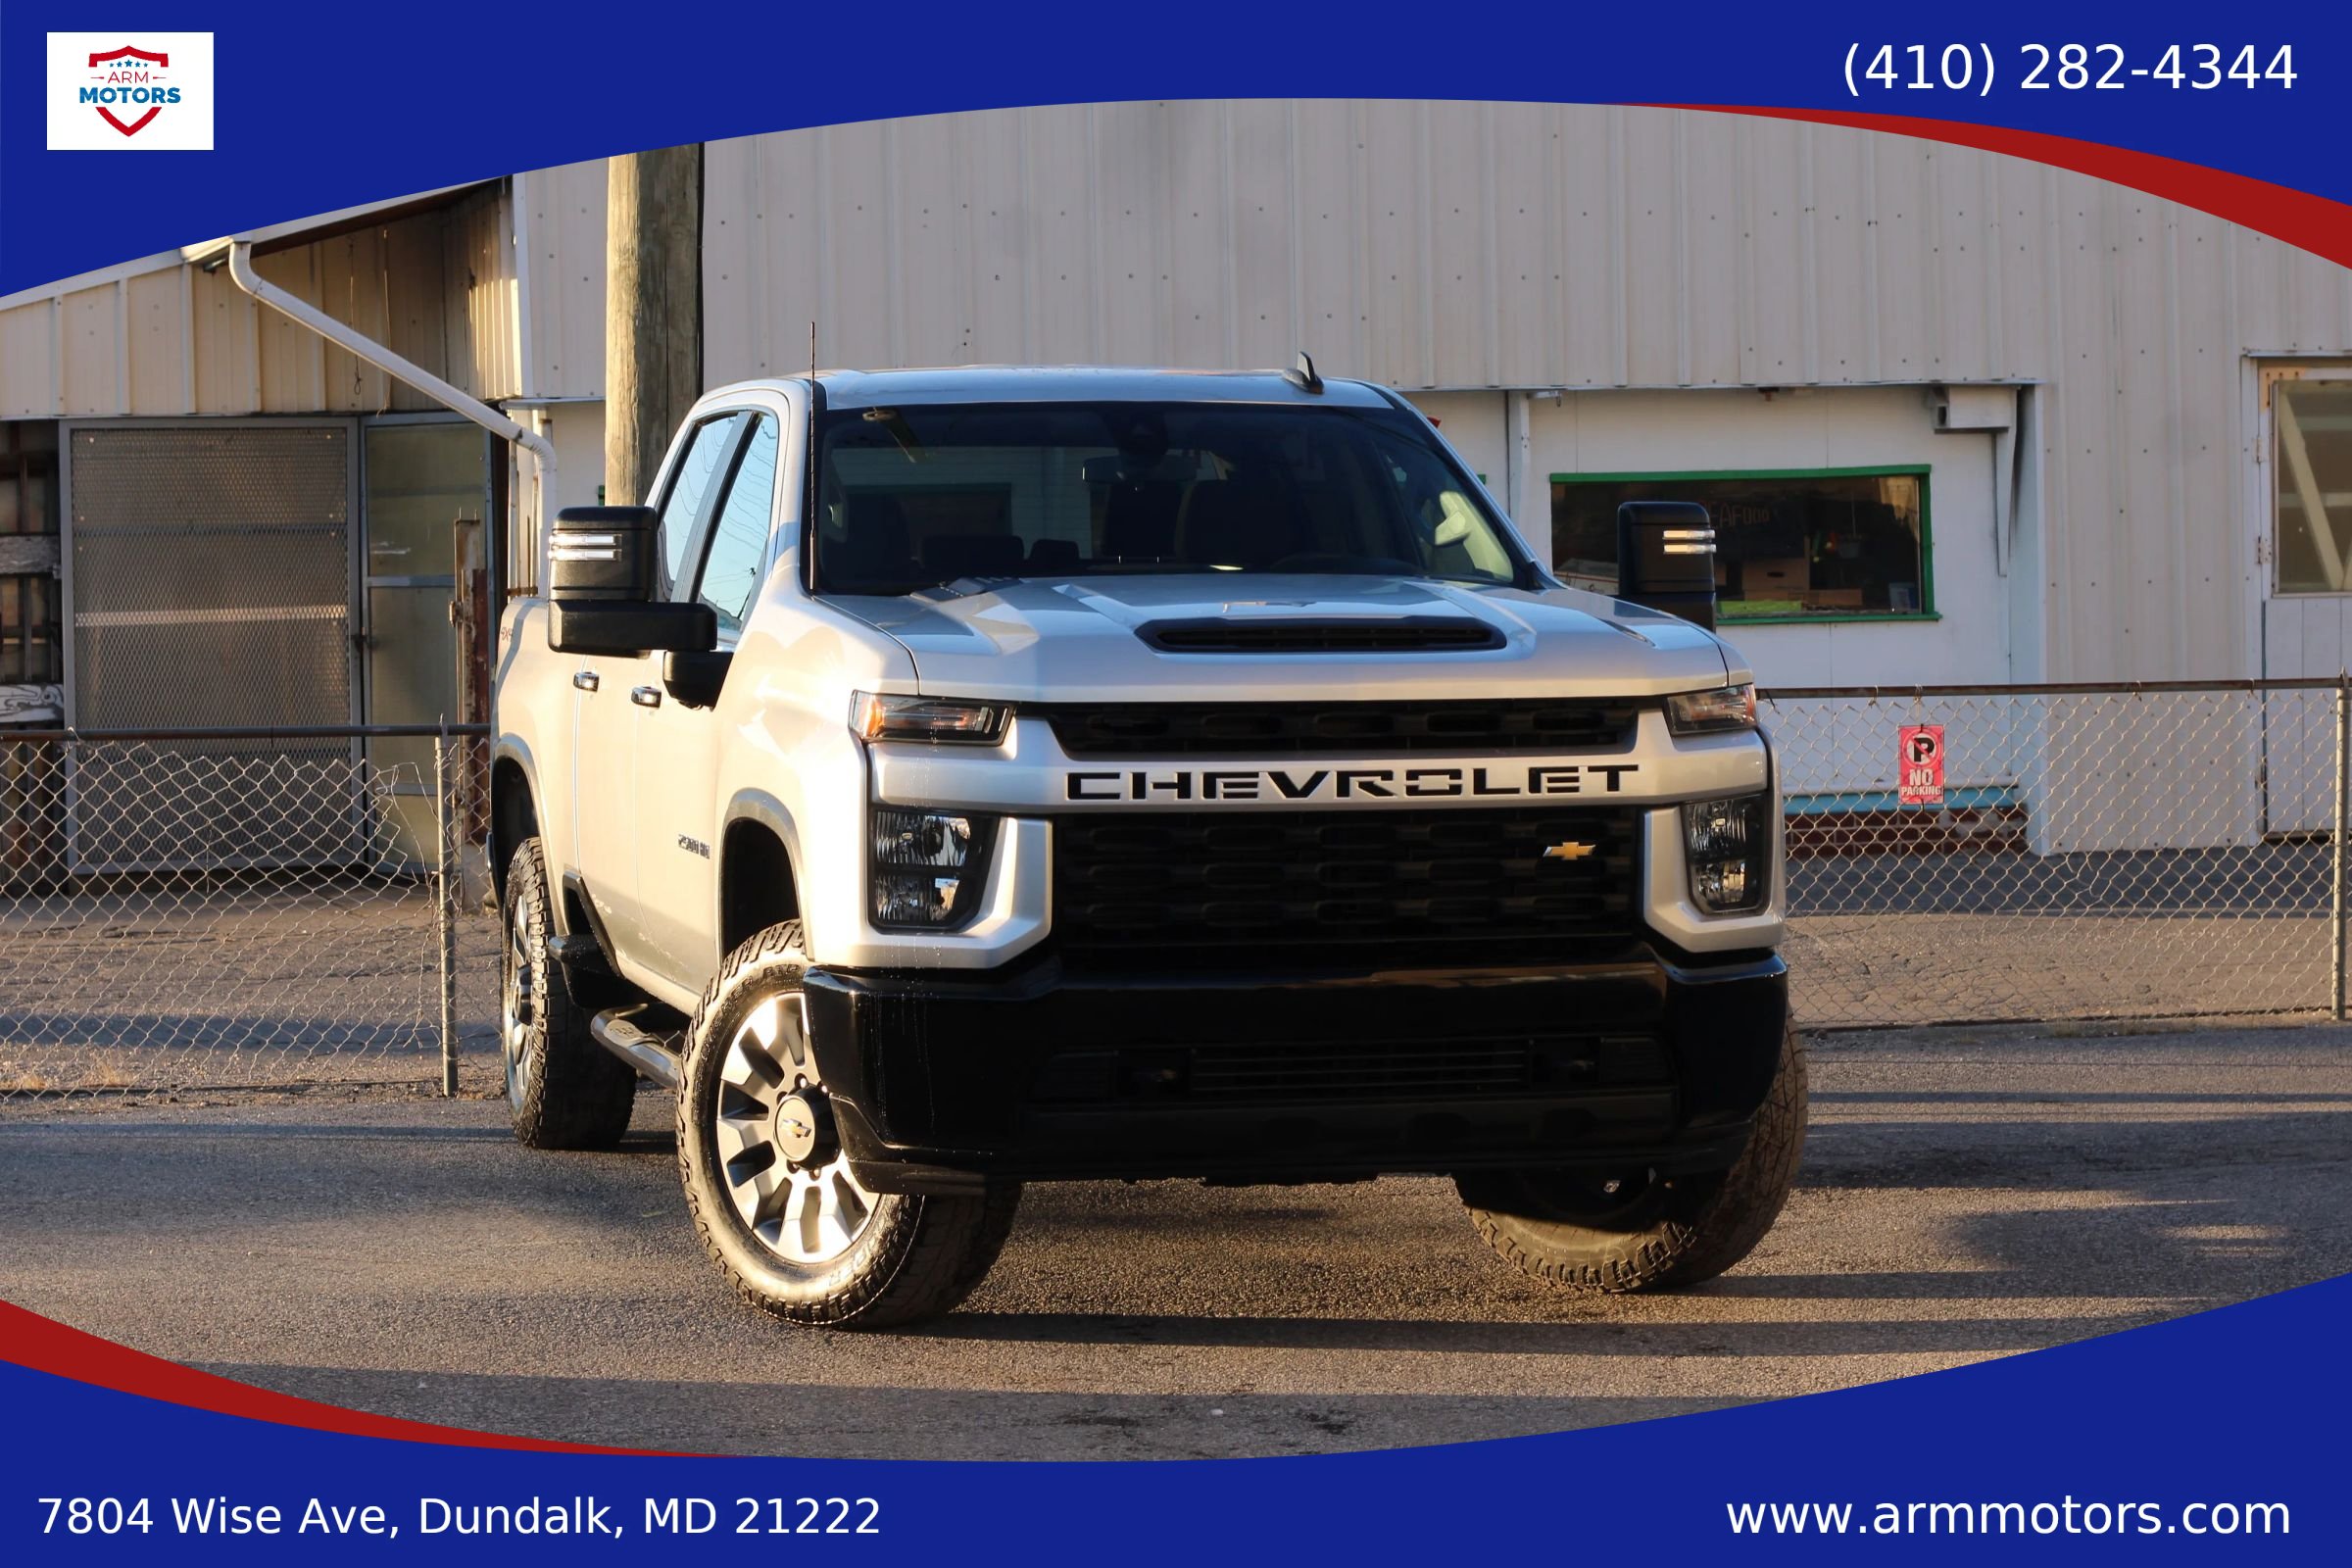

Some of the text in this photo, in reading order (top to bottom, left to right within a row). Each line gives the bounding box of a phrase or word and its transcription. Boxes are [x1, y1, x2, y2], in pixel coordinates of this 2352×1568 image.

[1066, 763, 1640, 802] CHEVROLET
[1909, 768, 1934, 786] NO
[1902, 786, 1941, 796] PARKING
